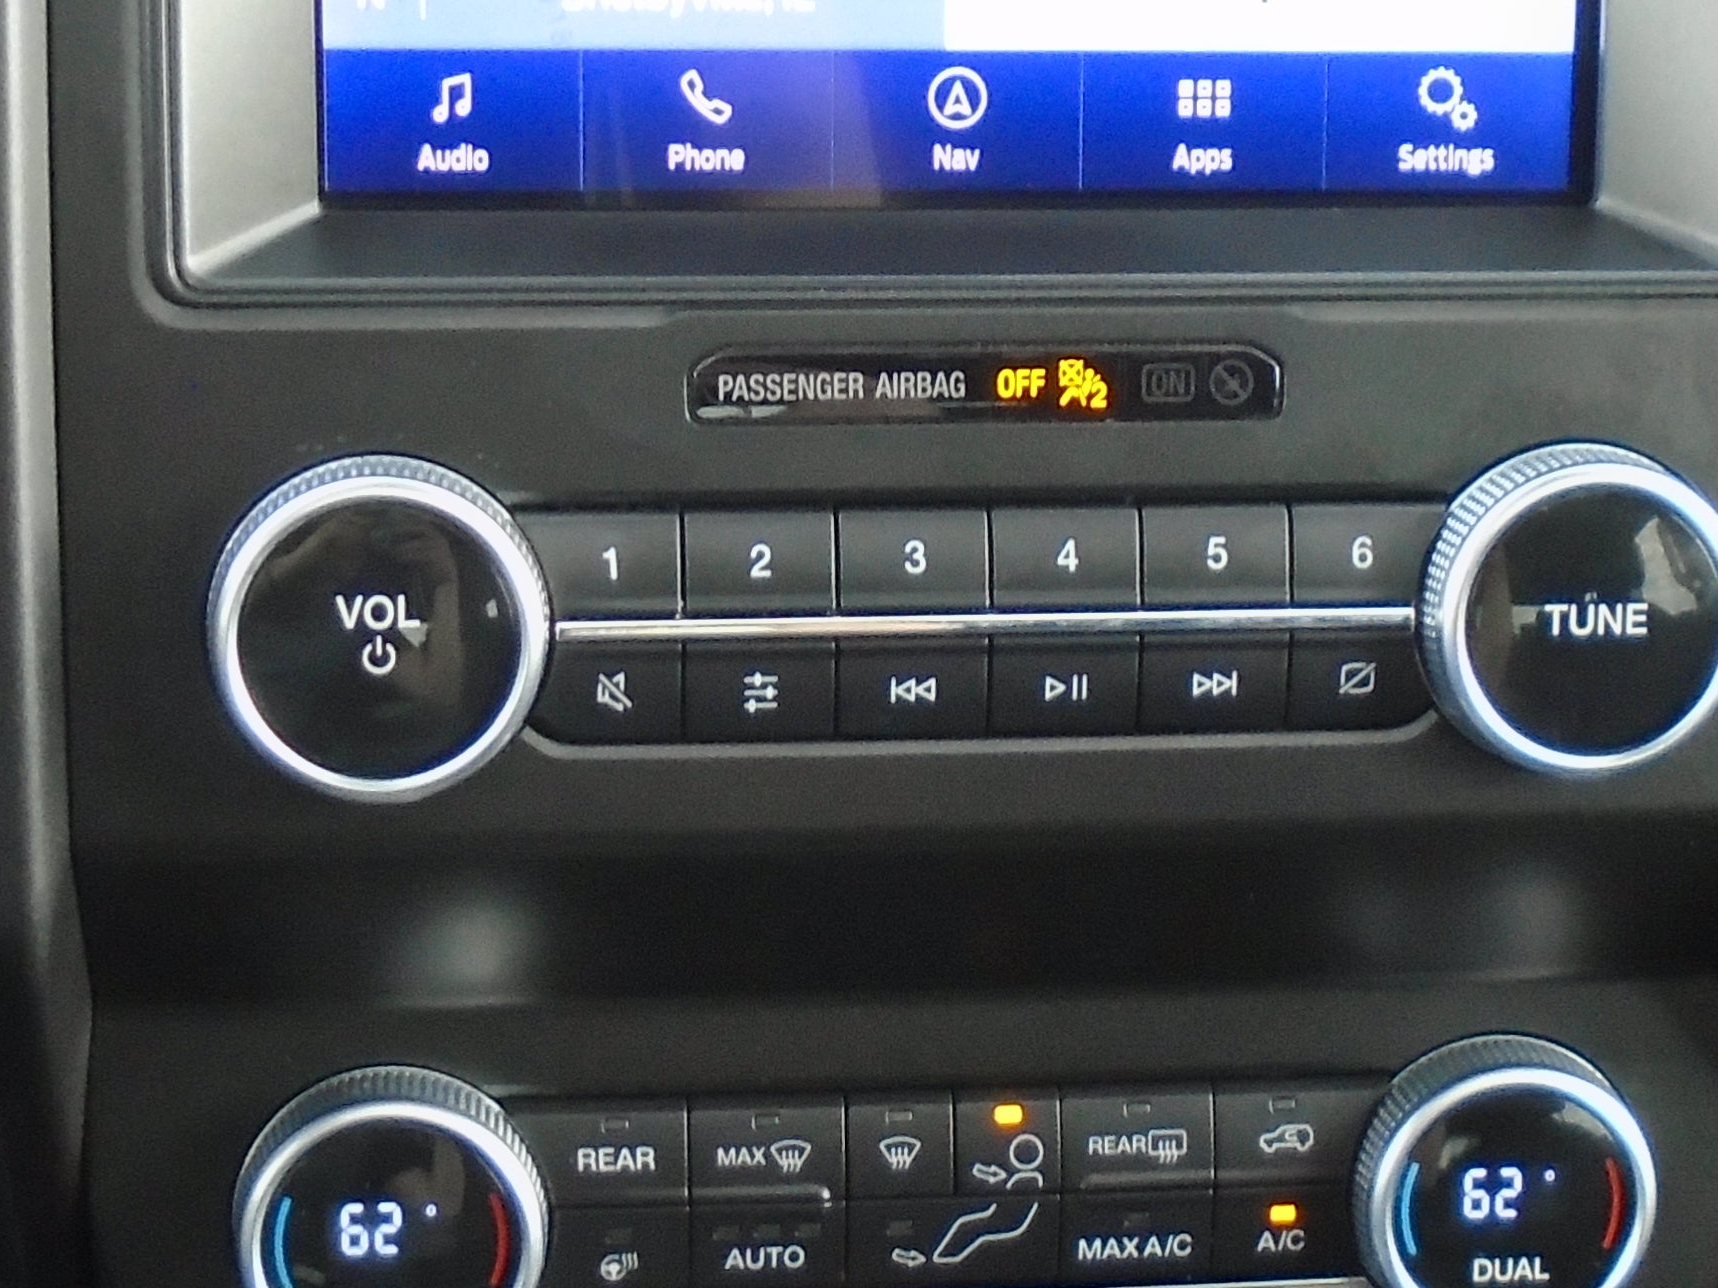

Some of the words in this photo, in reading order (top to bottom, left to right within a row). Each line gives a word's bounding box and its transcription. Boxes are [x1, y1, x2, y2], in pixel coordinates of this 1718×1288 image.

[417, 142, 489, 172] Audio
[667, 142, 746, 171] Phone
[932, 143, 981, 172] Nav
[1172, 142, 1233, 176] Apps
[1397, 143, 1495, 176] Settings
[717, 371, 865, 402] PASSENGER
[874, 370, 966, 401] AIRBAG
[995, 366, 1047, 402] OFF
[602, 546, 618, 581] 1
[750, 543, 772, 579] 2
[904, 539, 927, 575] 3
[1056, 538, 1079, 573] 4
[1206, 536, 1229, 571] 5
[1351, 535, 1374, 569] 6
[335, 594, 421, 629] VOL
[1543, 602, 1649, 637] TUNE
[577, 1146, 656, 1173] REAR
[716, 1146, 766, 1167] MAX
[1088, 1134, 1147, 1156] REAR
[1077, 1236, 1140, 1261] MAX
[1144, 1233, 1193, 1259] A/C
[1256, 1228, 1305, 1253] A/C
[724, 1244, 805, 1271] AUTO
[1472, 1256, 1550, 1284] DUAL
